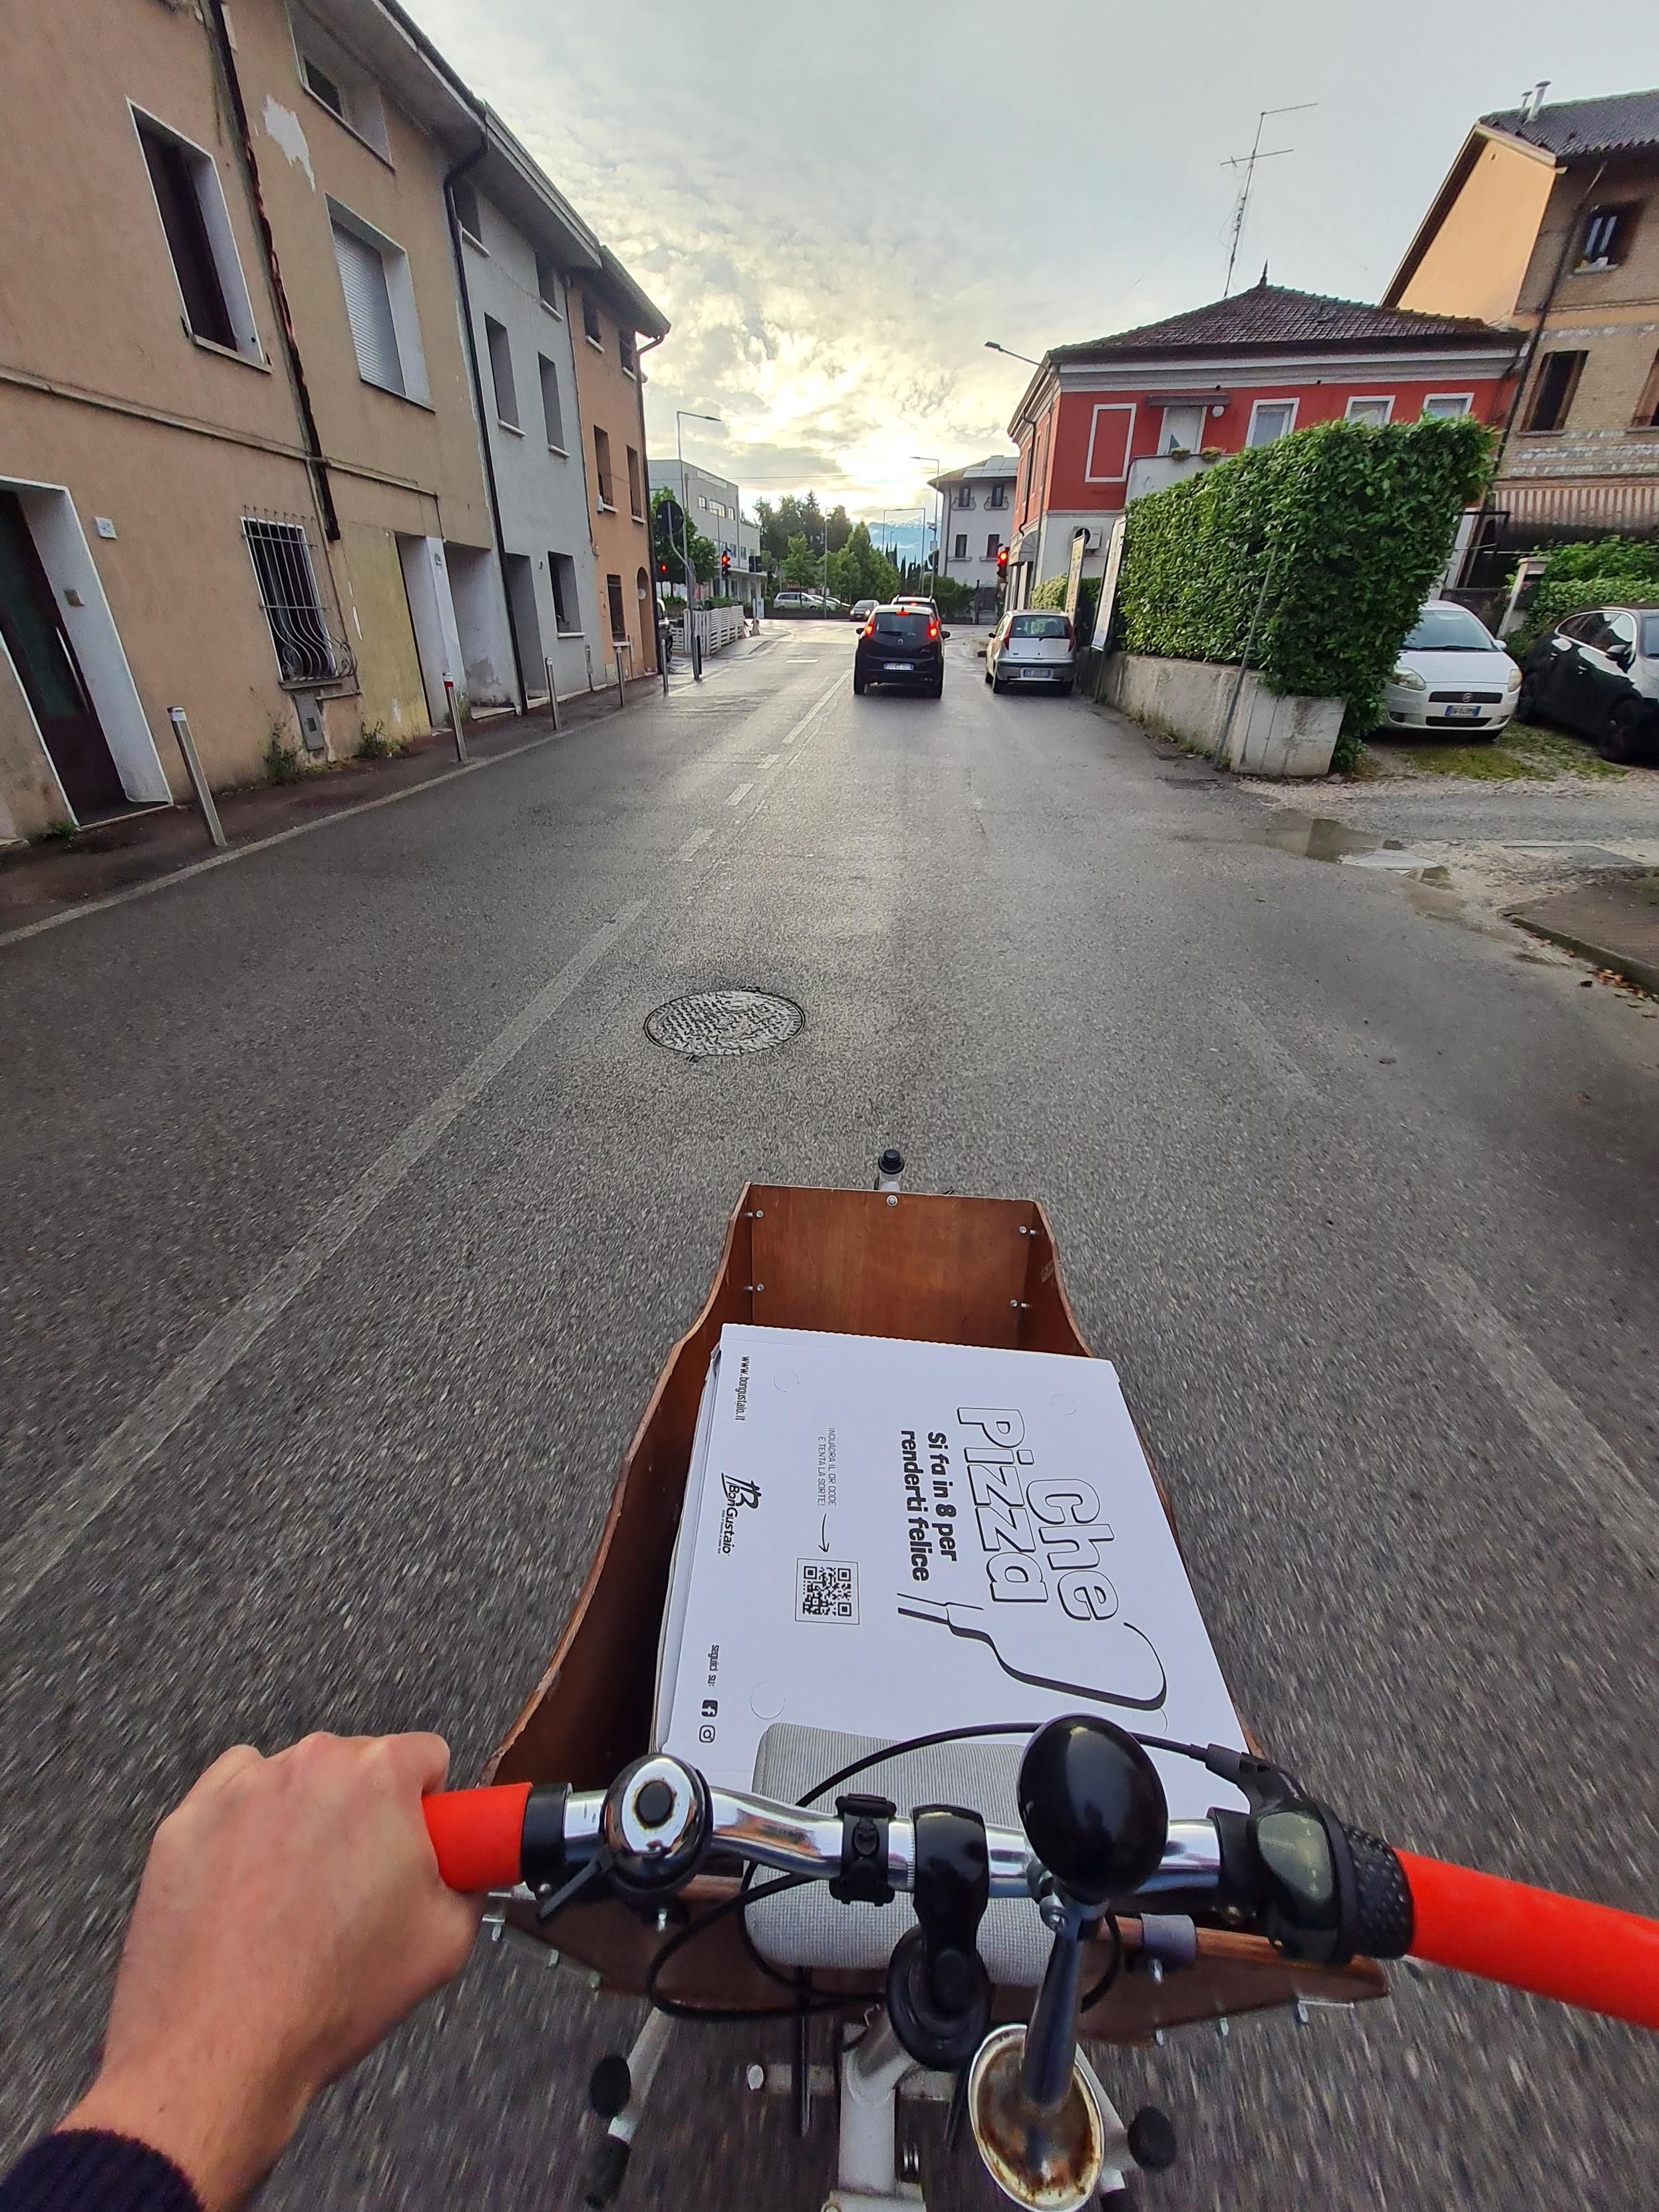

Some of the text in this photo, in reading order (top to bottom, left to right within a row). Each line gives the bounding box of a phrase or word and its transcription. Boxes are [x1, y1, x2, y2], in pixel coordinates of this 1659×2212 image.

[734, 1356, 750, 1420] www.bongustaio.it
[818, 1444, 826, 1466] TENTA
[818, 1467, 826, 1477] LA
[722, 1484, 740, 1554] BonGustaio
[818, 1478, 826, 1506] SORTE!
[828, 1486, 837, 1507] CODE
[901, 1430, 933, 1581] renderti felice
[927, 1432, 957, 1562] Si fa in 8 per
[957, 1407, 1048, 1603] Pizza
[1026, 1478, 1119, 1621] Che
[707, 1645, 719, 1686] seguici su:
